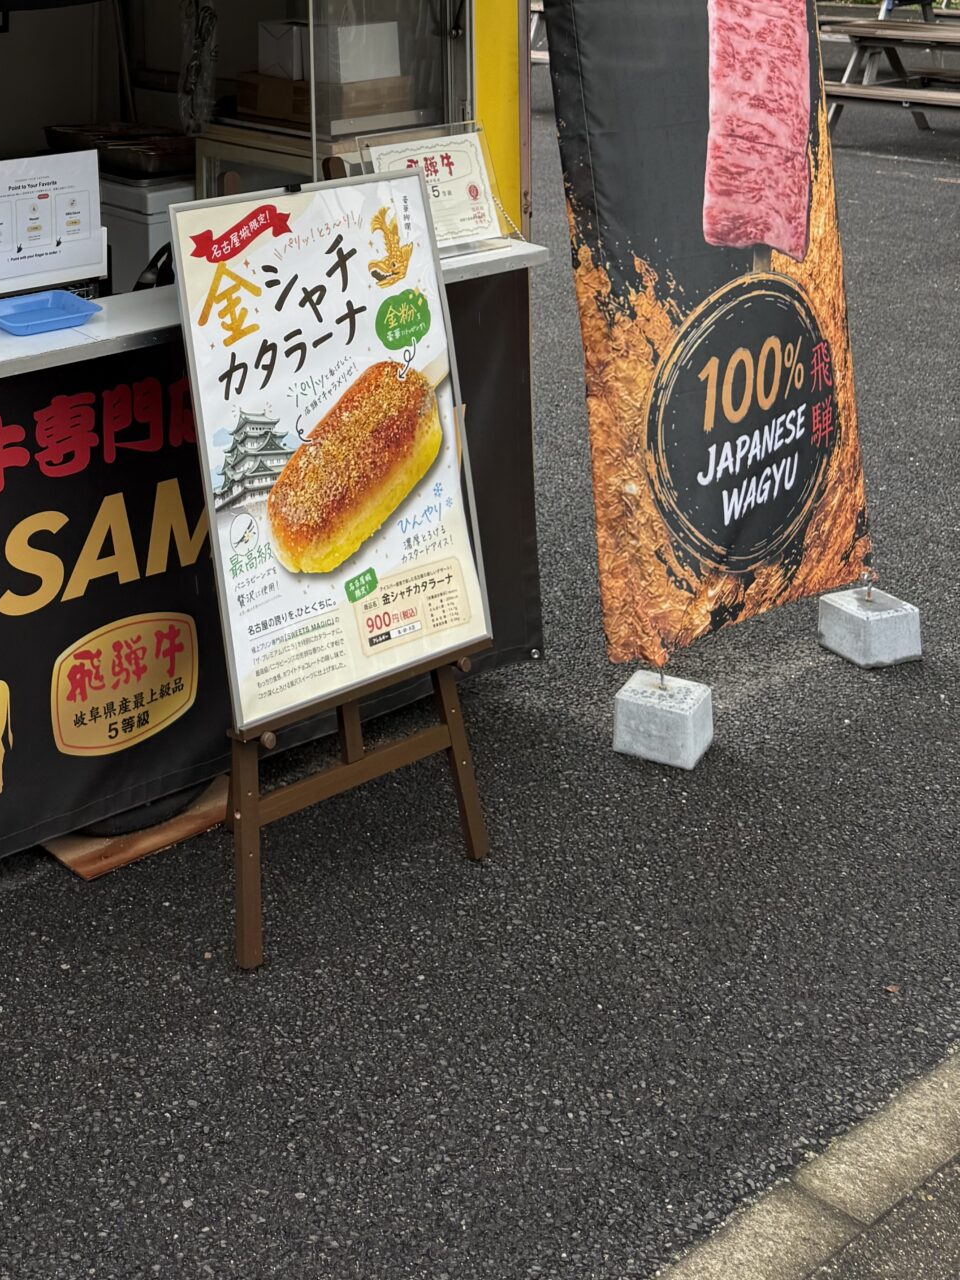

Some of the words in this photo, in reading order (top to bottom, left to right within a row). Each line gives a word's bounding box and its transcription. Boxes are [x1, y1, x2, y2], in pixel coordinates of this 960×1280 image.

[198, 234, 357, 347] 金シャチ
[218, 300, 367, 401] カタラーナ
[698, 335, 804, 433] 100%
[697, 403, 806, 486] JAPANESE
[721, 452, 798, 526] WAGYU
[229, 541, 274, 579] 最高級
[382, 573, 454, 606] 金シャチカタラーナ
[66, 623, 185, 703] 飛騨牛
[73, 676, 185, 729] 岐阜県産最上級品
[108, 710, 150, 740] 5等級
